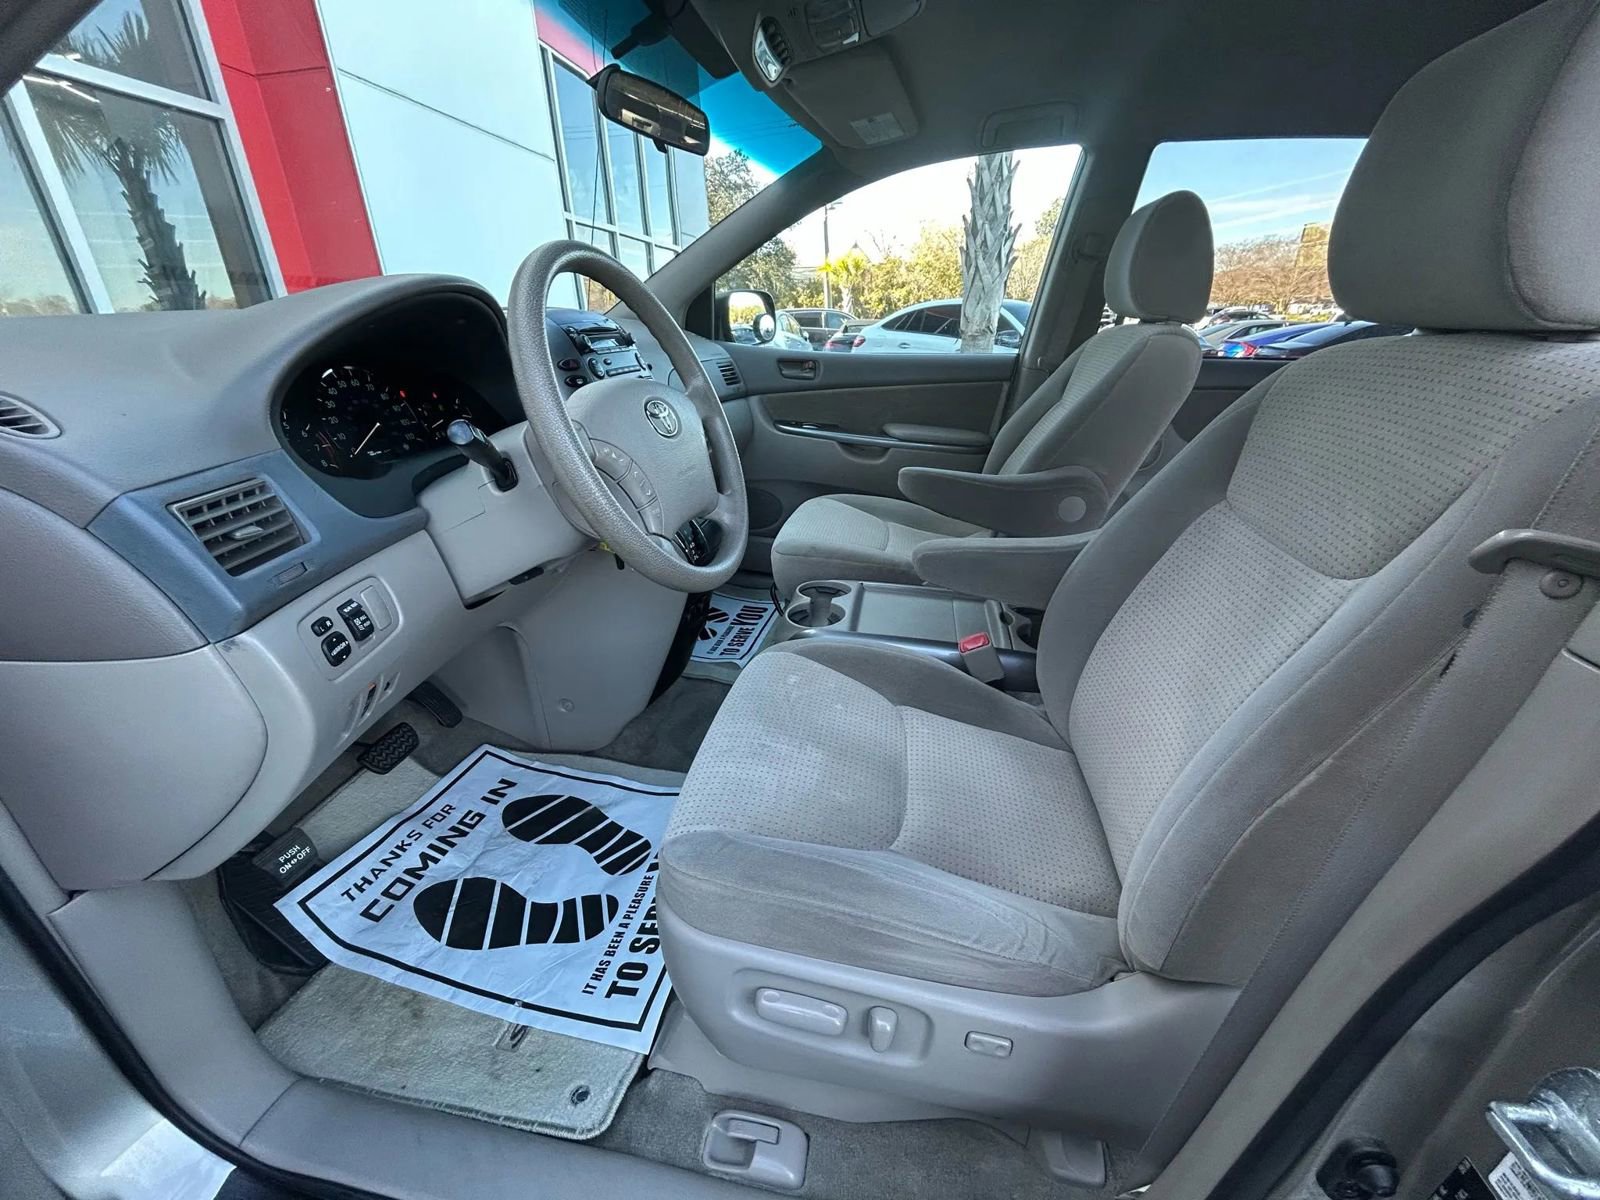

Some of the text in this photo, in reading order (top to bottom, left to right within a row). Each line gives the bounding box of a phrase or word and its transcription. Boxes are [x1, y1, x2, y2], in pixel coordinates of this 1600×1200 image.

[730, 605, 768, 626] YOU
[727, 627, 755, 647] SERVE
[719, 648, 740, 656] TO
[278, 844, 300, 863] PUSH
[340, 803, 456, 902] THANKS FOR
[360, 778, 518, 923] COMING IN
[581, 982, 598, 995] IT
[590, 959, 611, 981] HAS
[604, 931, 625, 957] BEEN
[623, 875, 654, 920] PLEASURE
[605, 961, 648, 998] TO
